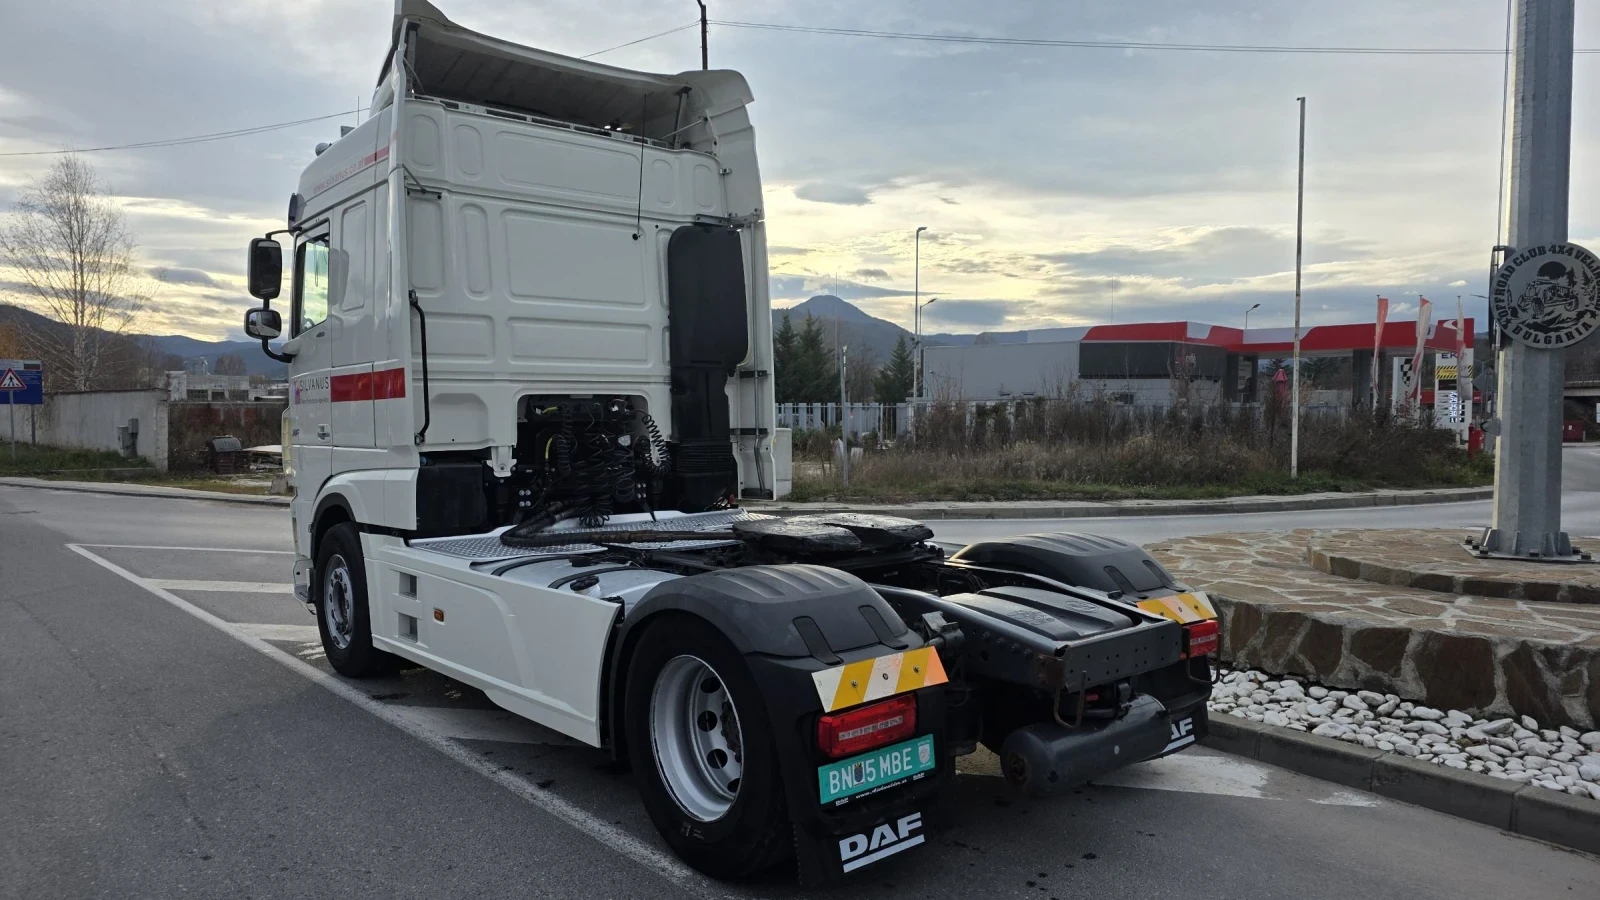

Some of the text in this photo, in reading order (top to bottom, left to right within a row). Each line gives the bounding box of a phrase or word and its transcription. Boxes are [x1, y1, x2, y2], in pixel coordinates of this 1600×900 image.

[1494, 265, 1516, 318] OFFROAD
[1512, 245, 1547, 267] CLUB
[1548, 244, 1575, 256] 4X4
[1512, 321, 1593, 345] BULGARIA
[300, 376, 329, 391] SILVANUS
[1171, 717, 1193, 740] AF
[879, 747, 913, 779] MBE
[838, 811, 923, 862] DAF
